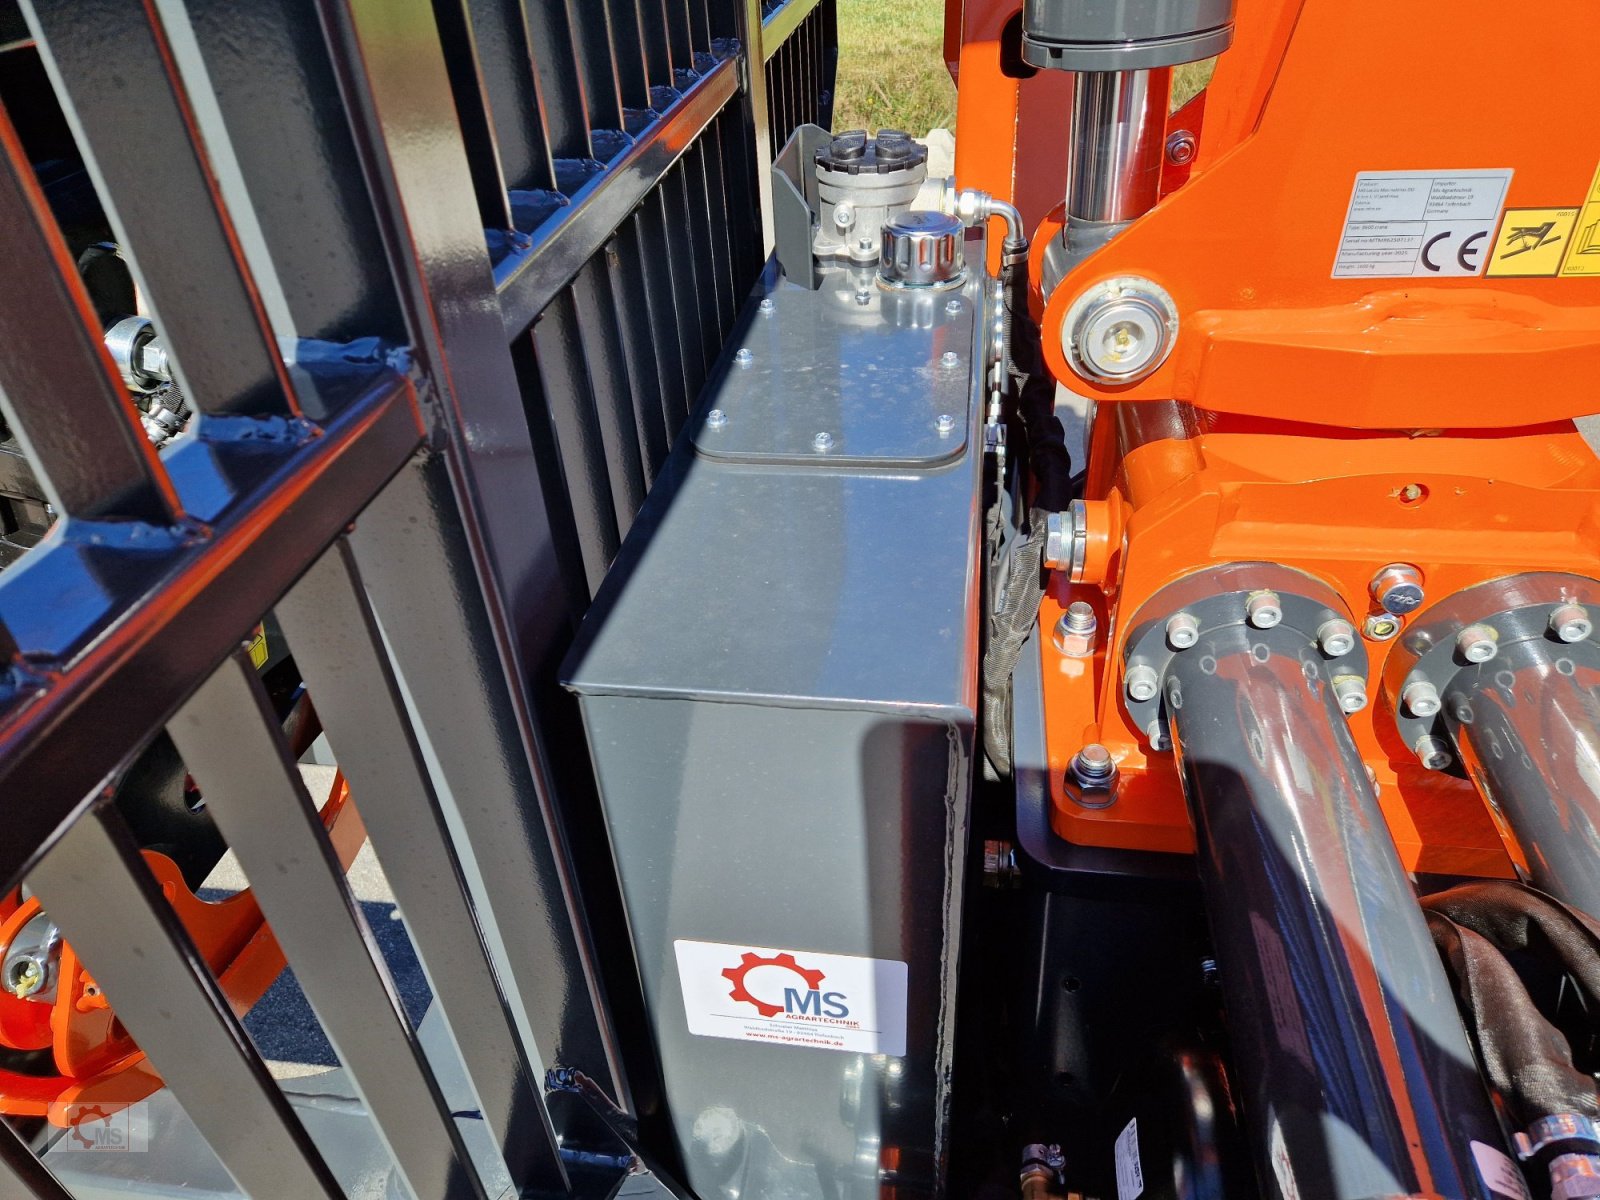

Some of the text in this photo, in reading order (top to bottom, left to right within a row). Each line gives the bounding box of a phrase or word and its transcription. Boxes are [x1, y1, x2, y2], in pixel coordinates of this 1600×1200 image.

[1421, 231, 1488, 272] CE
[784, 987, 850, 1019] MS
[785, 1014, 860, 1026] AGRARTECHNIK
[745, 1032, 844, 1046] www.ms-agrartechnik.de
